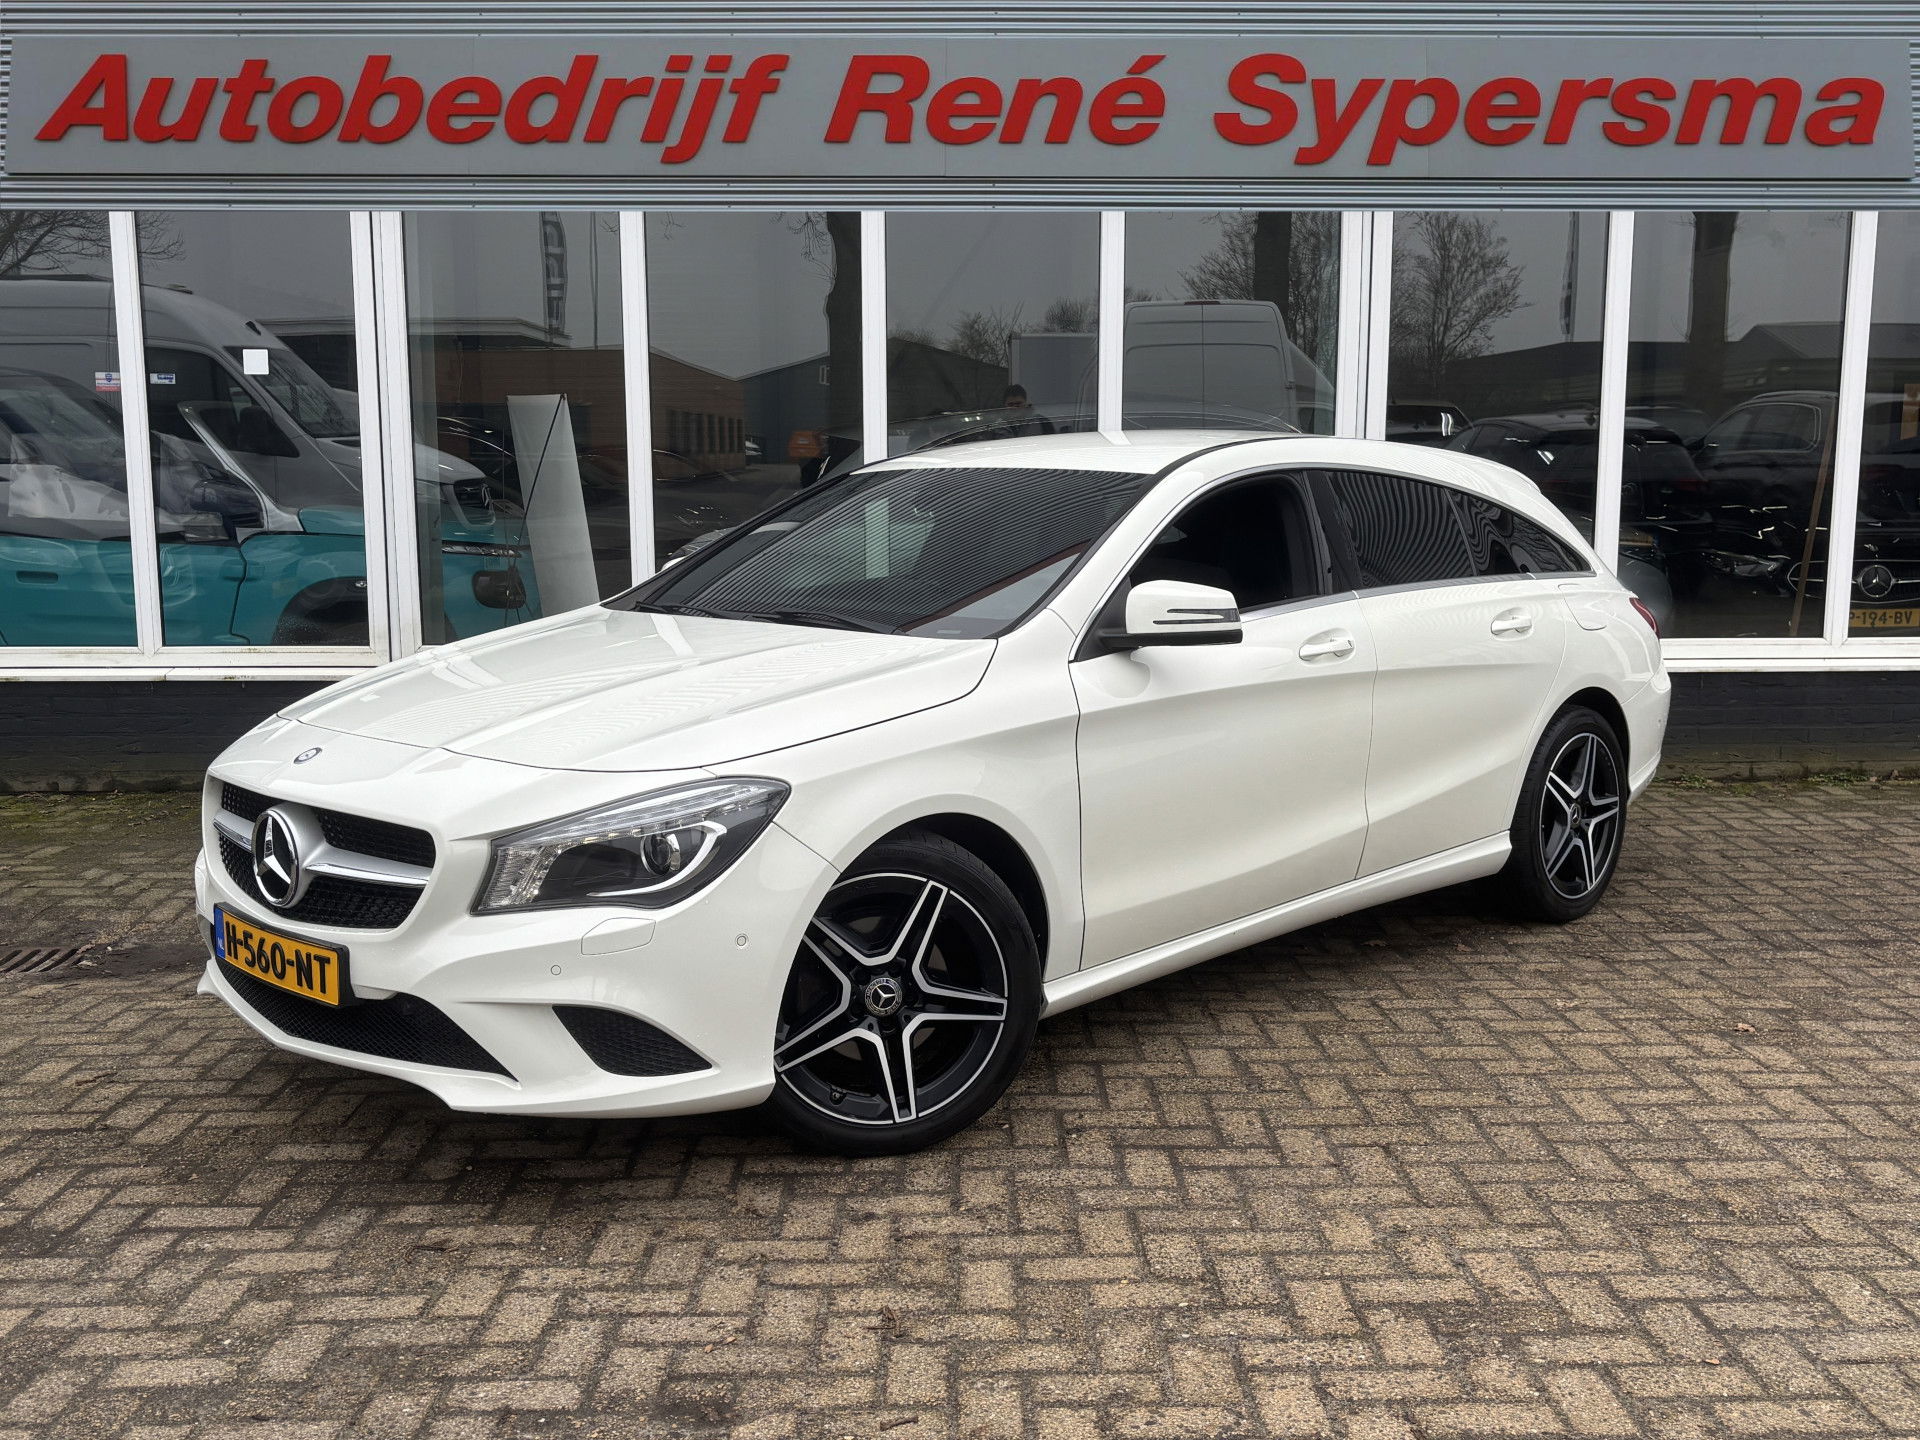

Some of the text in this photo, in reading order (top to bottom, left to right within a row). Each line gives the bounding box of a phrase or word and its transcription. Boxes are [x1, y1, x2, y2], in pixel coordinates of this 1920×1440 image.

[37, 54, 1885, 165] Autobedrijf René Sypersma
[225, 921, 331, 995] H-560-NT
